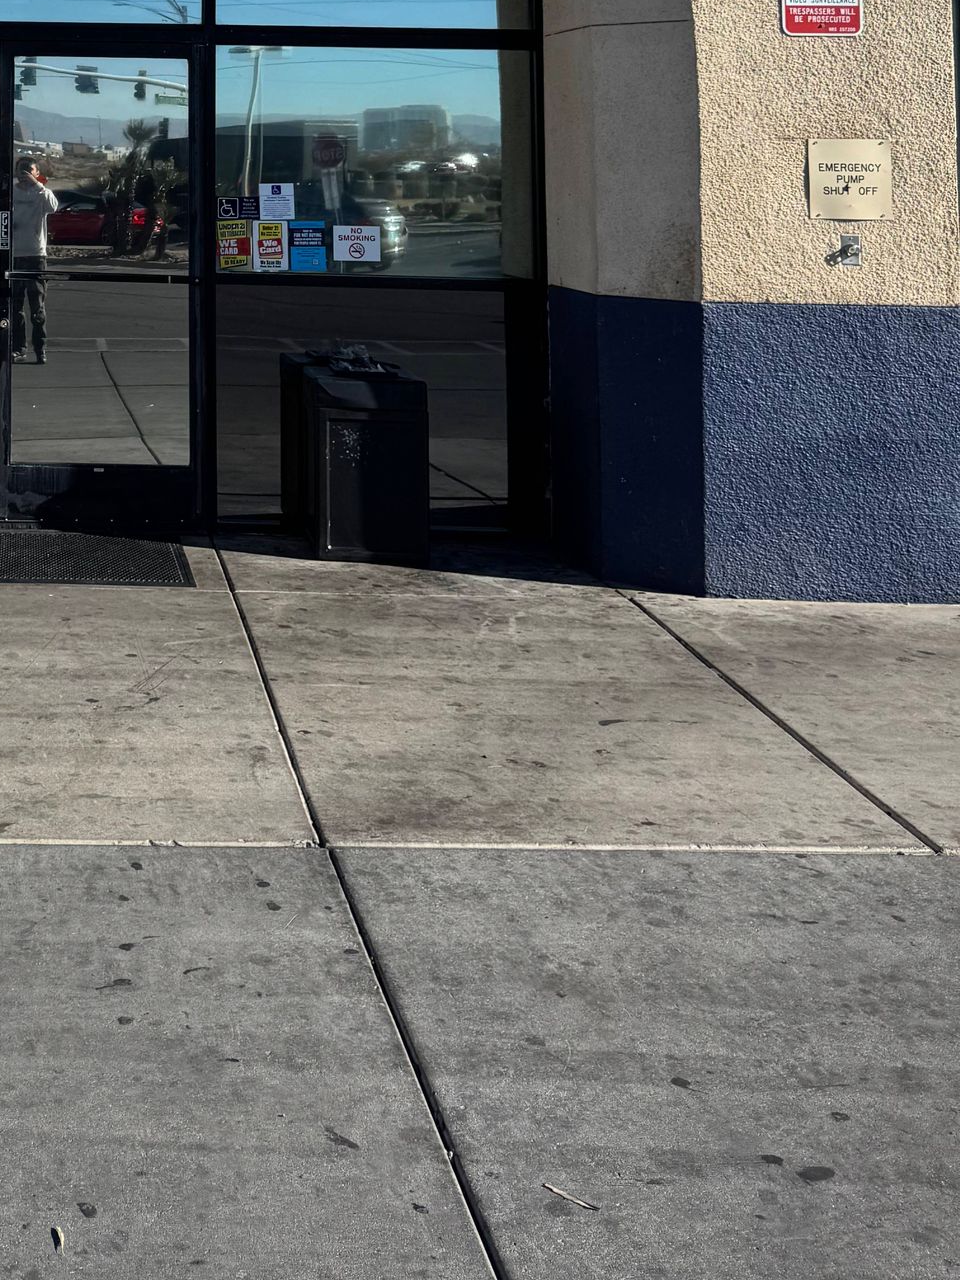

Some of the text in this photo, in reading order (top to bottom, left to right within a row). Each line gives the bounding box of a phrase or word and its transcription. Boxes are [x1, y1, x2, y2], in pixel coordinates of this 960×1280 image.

[818, 163, 881, 172] EMERGENCY
[836, 175, 865, 184] PUMP
[823, 186, 878, 195] SHUT OFF
[338, 234, 376, 242] SMOKING
[262, 239, 278, 247] We
[259, 245, 282, 254] Card
